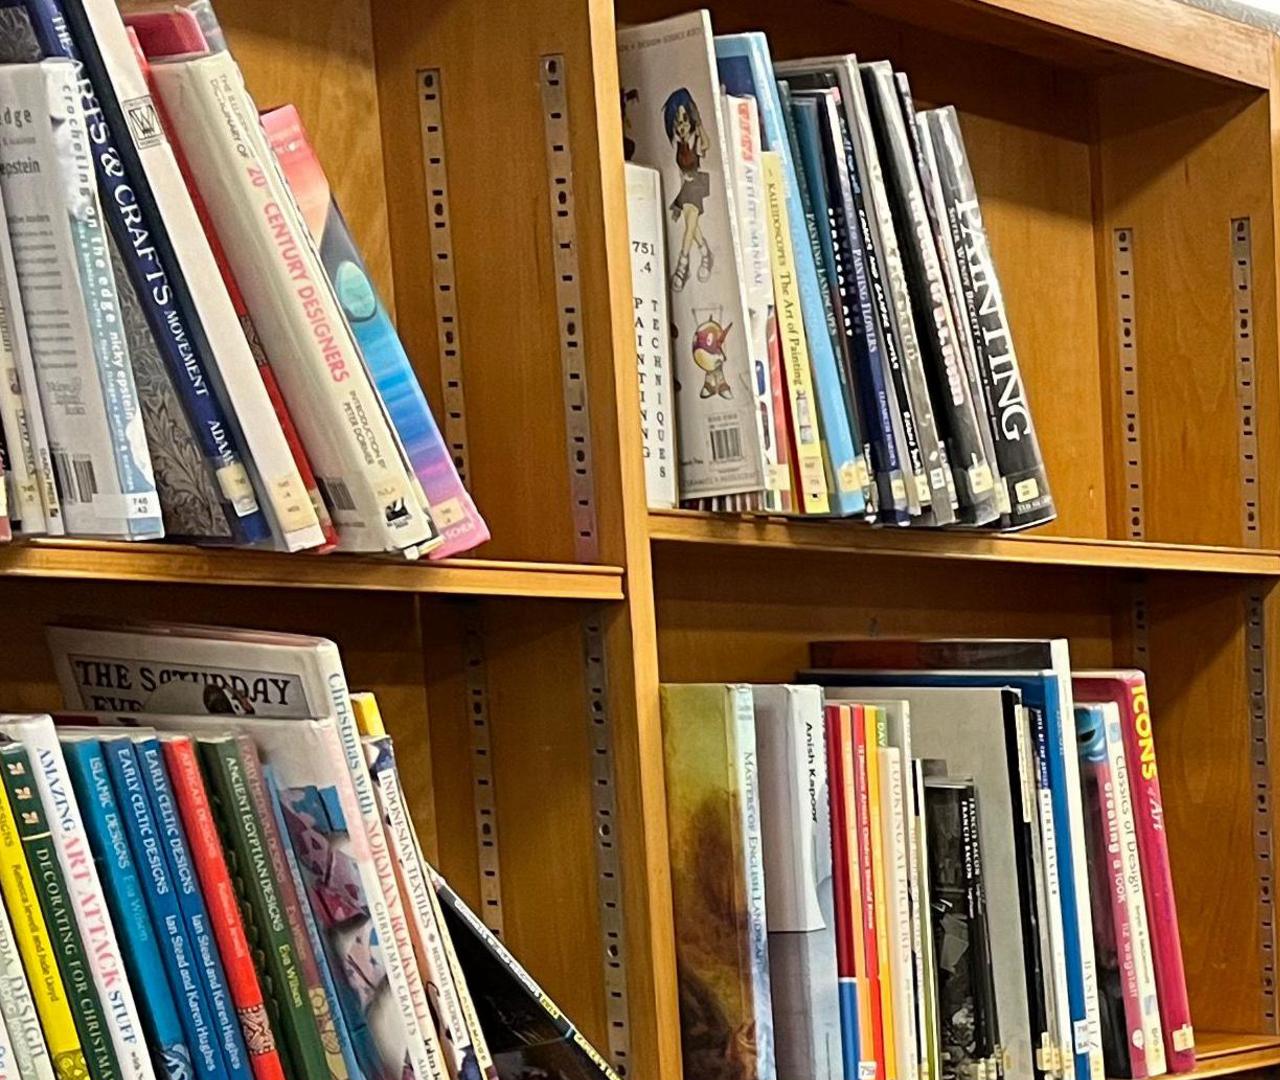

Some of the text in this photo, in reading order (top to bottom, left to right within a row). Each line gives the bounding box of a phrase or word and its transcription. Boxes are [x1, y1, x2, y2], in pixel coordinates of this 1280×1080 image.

[51, 13, 210, 397] THE ARTS & CRAFTS MOVEMENT
[62, 83, 137, 421] crocheting on the edge nicky epstein
[632, 240, 655, 256] 751
[639, 260, 652, 273] .4
[766, 181, 804, 386] KALEIDOSCOPES The Art of Painting
[650, 299, 667, 479] TECHNIQUES
[954, 198, 1031, 441] PAINTING
[74, 660, 133, 690] THE
[804, 721, 819, 823] Anish Kapoor
[226, 756, 303, 1009] ANCIENT EGYPTIAN DESIGNS Eva Wilson
[328, 672, 361, 770] Christmas
[355, 773, 375, 816] with
[366, 818, 399, 908] NORMAN
[892, 759, 910, 965] LOOKING AT PICTURES
[1115, 754, 1140, 895] Classics of Design
[36, 850, 77, 956] DECORATING
[68, 958, 90, 994] FOR
[37, 746, 138, 1044] AMAZING ART ATTACK STUFF
[117, 747, 216, 1072] EARLY CELTIC DESIGNS Ian Stead and Karen Hughes
[145, 748, 241, 1071] EARLY CELTIC DESIGNS Ian Stead and Karen Hughes
